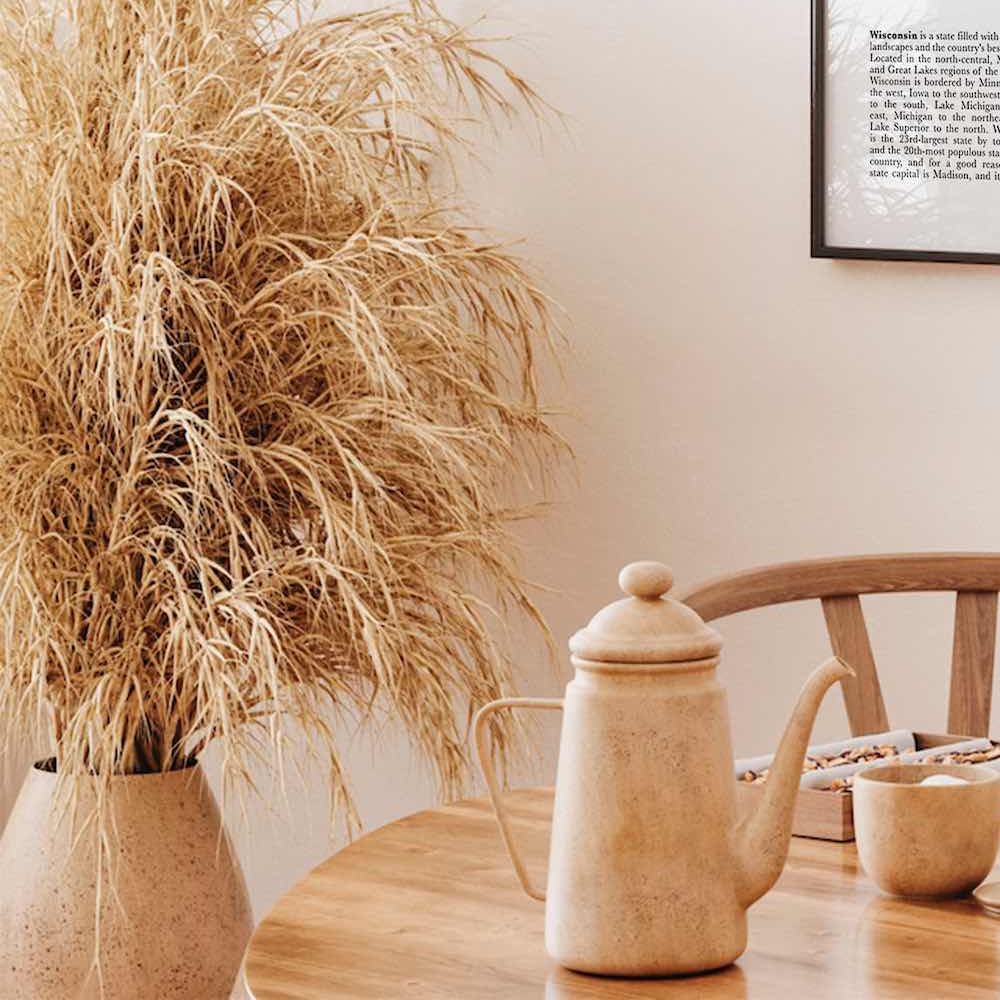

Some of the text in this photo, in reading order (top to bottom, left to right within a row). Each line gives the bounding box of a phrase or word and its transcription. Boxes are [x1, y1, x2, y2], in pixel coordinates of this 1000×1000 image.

[869, 30, 919, 40] Wisconsin
[920, 31, 927, 40] is
[935, 32, 955, 40] state
[956, 31, 979, 40] filled
[980, 31, 1000, 40] with
[870, 42, 914, 54] landscapes
[914, 42, 931, 51] and
[932, 42, 946, 52] the
[870, 65, 885, 74] and
[888, 65, 911, 74] Great
[914, 65, 938, 75] Lakes
[941, 65, 970, 78] regions
[972, 66, 982, 75] of
[985, 66, 998, 75] the
[870, 87, 882, 97] the
[909, 88, 929, 97] Iowa
[932, 89, 941, 98] to
[944, 89, 957, 98] the
[870, 133, 876, 142] is
[881, 133, 894, 143] the
[953, 136, 972, 145] state
[977, 136, 988, 148] by
[908, 157, 923, 167] and
[929, 158, 940, 167] for
[956, 158, 977, 171] good
[869, 169, 889, 177] state
[892, 168, 919, 181] capital
[923, 169, 930, 178] is
[975, 170, 991, 180] and
